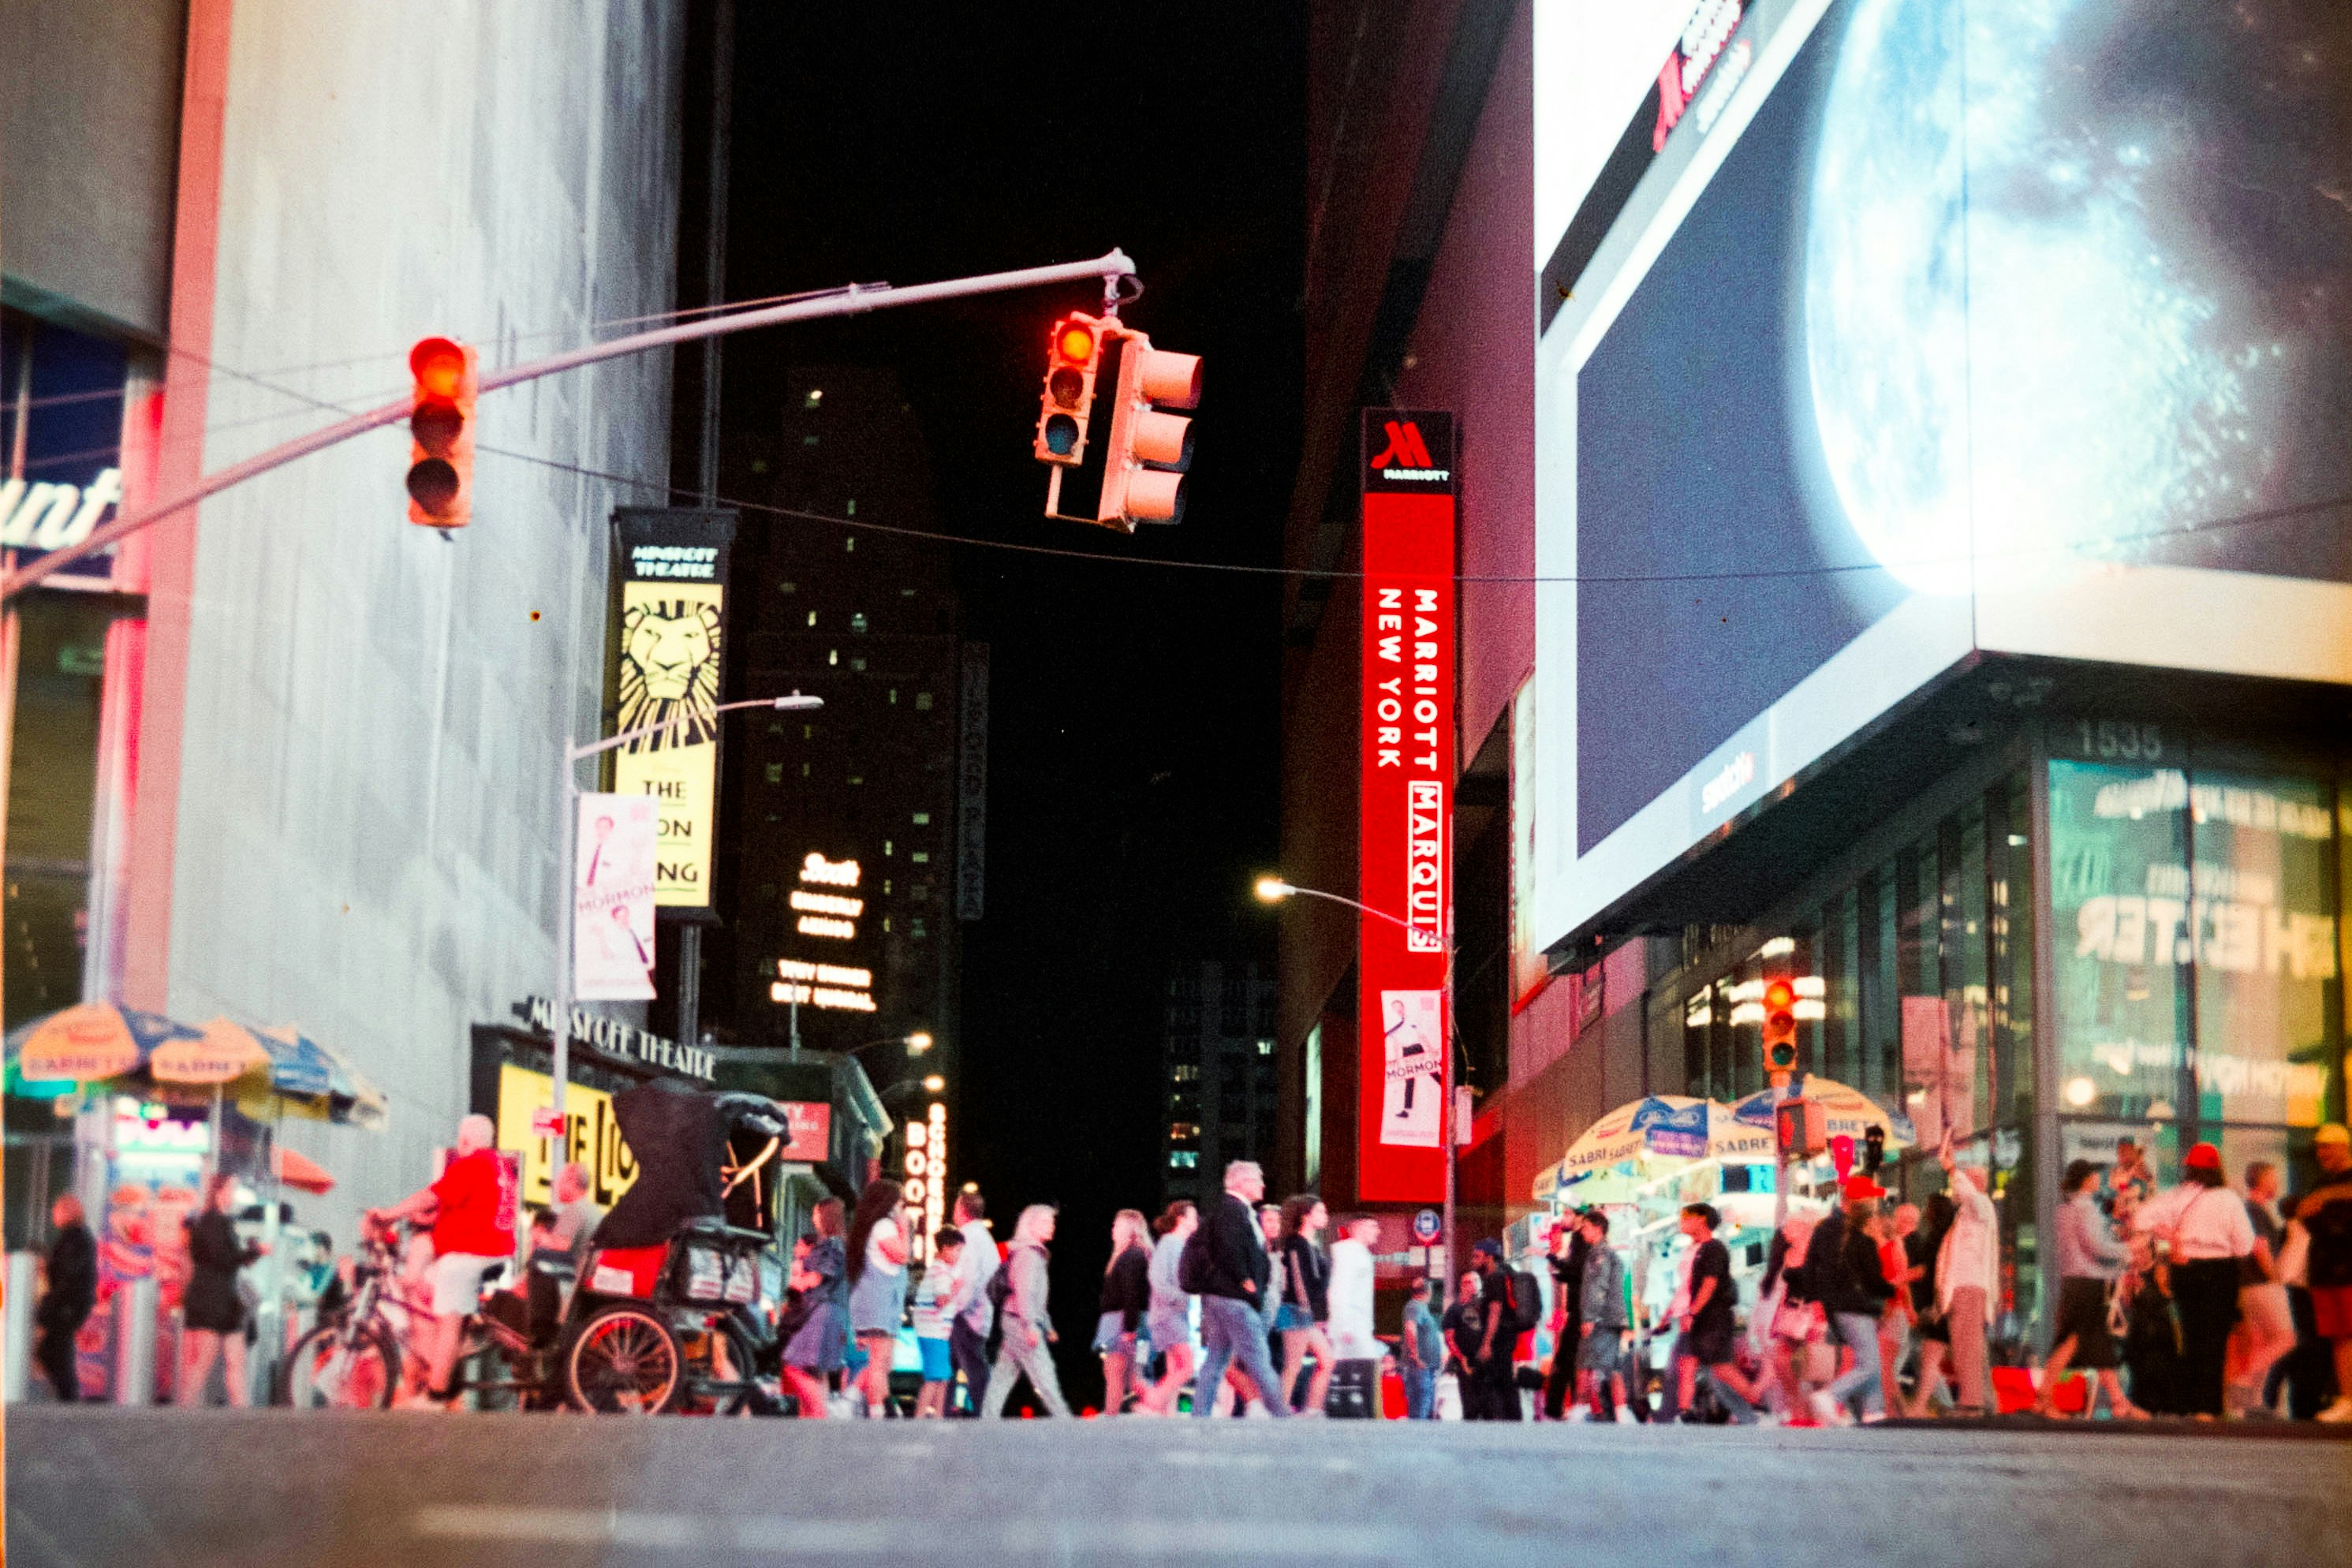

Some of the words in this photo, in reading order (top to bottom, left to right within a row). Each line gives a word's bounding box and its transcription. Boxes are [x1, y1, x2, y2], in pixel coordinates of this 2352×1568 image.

[1383, 469, 1450, 480] MARRIOTT
[1378, 588, 1402, 663] NEW
[1413, 589, 1438, 771] MARRIOTT
[1378, 678, 1402, 767] YORK
[2079, 719, 2163, 760] 1535
[643, 780, 686, 798] THE
[657, 819, 692, 837] ON
[657, 862, 698, 883] NG
[1413, 786, 1437, 946] MARQUIS
[532, 995, 631, 1054] MISKOFF
[638, 1029, 715, 1081] THEATRE
[1387, 1059, 1442, 1079] MORMON
[1715, 1137, 1769, 1154] SABRE
